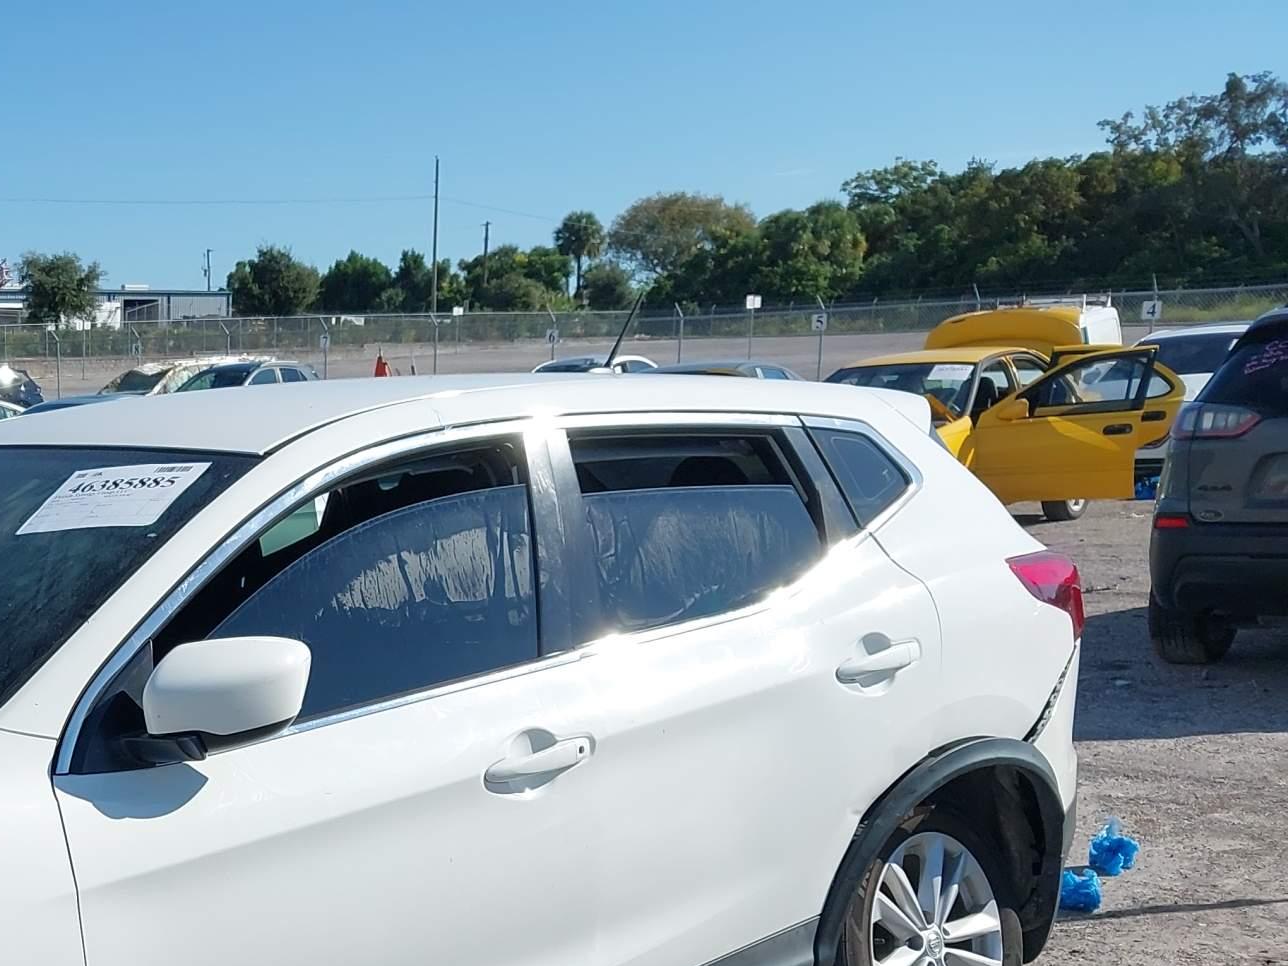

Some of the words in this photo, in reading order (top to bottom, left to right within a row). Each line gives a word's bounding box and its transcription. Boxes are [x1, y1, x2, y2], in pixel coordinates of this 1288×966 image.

[1146, 303, 1157, 318] 4
[815, 315, 824, 329] 5
[548, 330, 556, 344] 6
[68, 475, 180, 494] 46385885
